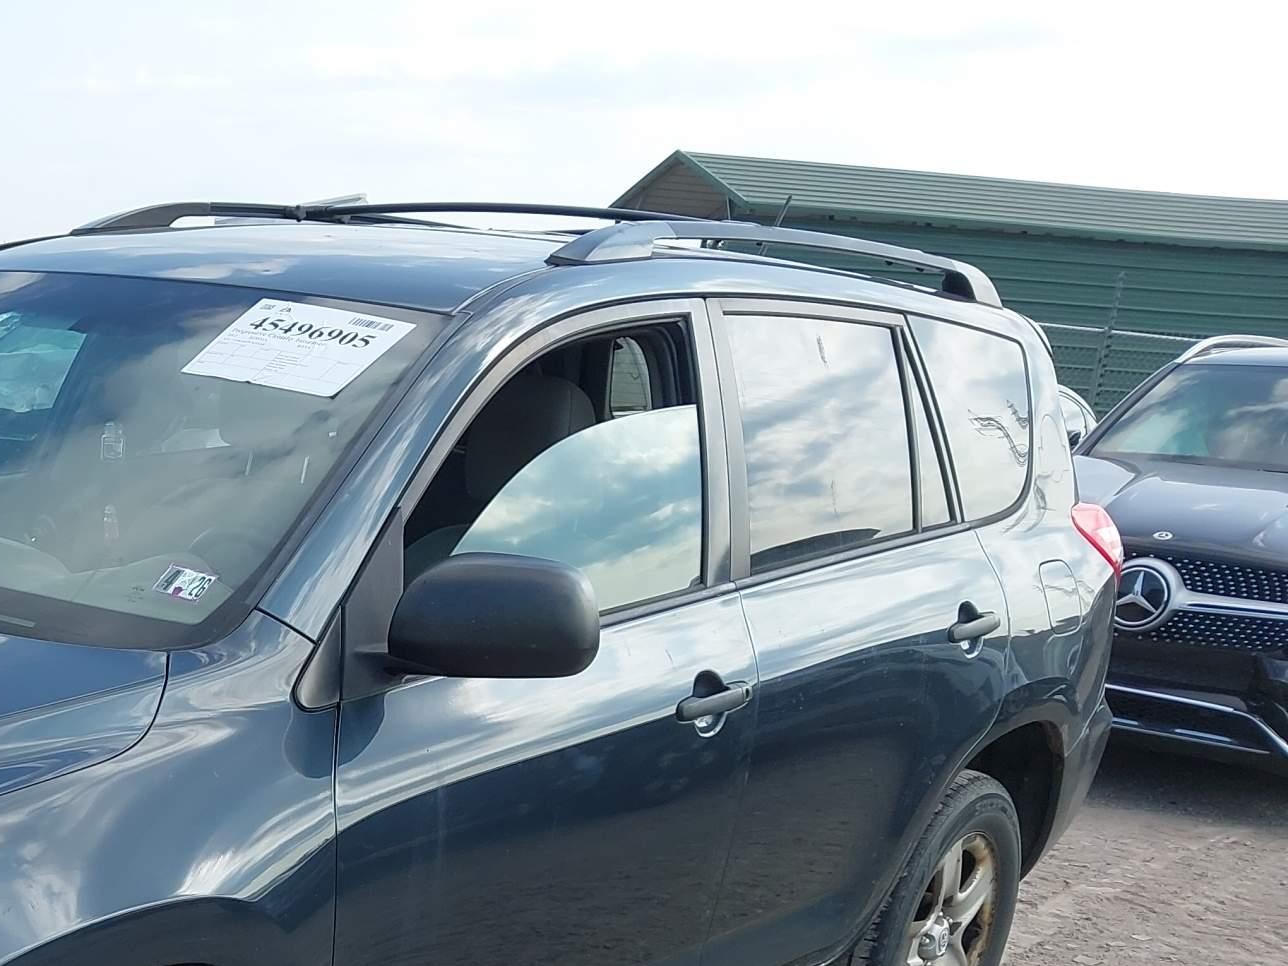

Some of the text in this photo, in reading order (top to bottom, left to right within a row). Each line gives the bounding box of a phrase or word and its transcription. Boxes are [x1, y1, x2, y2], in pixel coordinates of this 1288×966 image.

[249, 316, 377, 349] 45496905
[162, 570, 212, 598] 4 26
